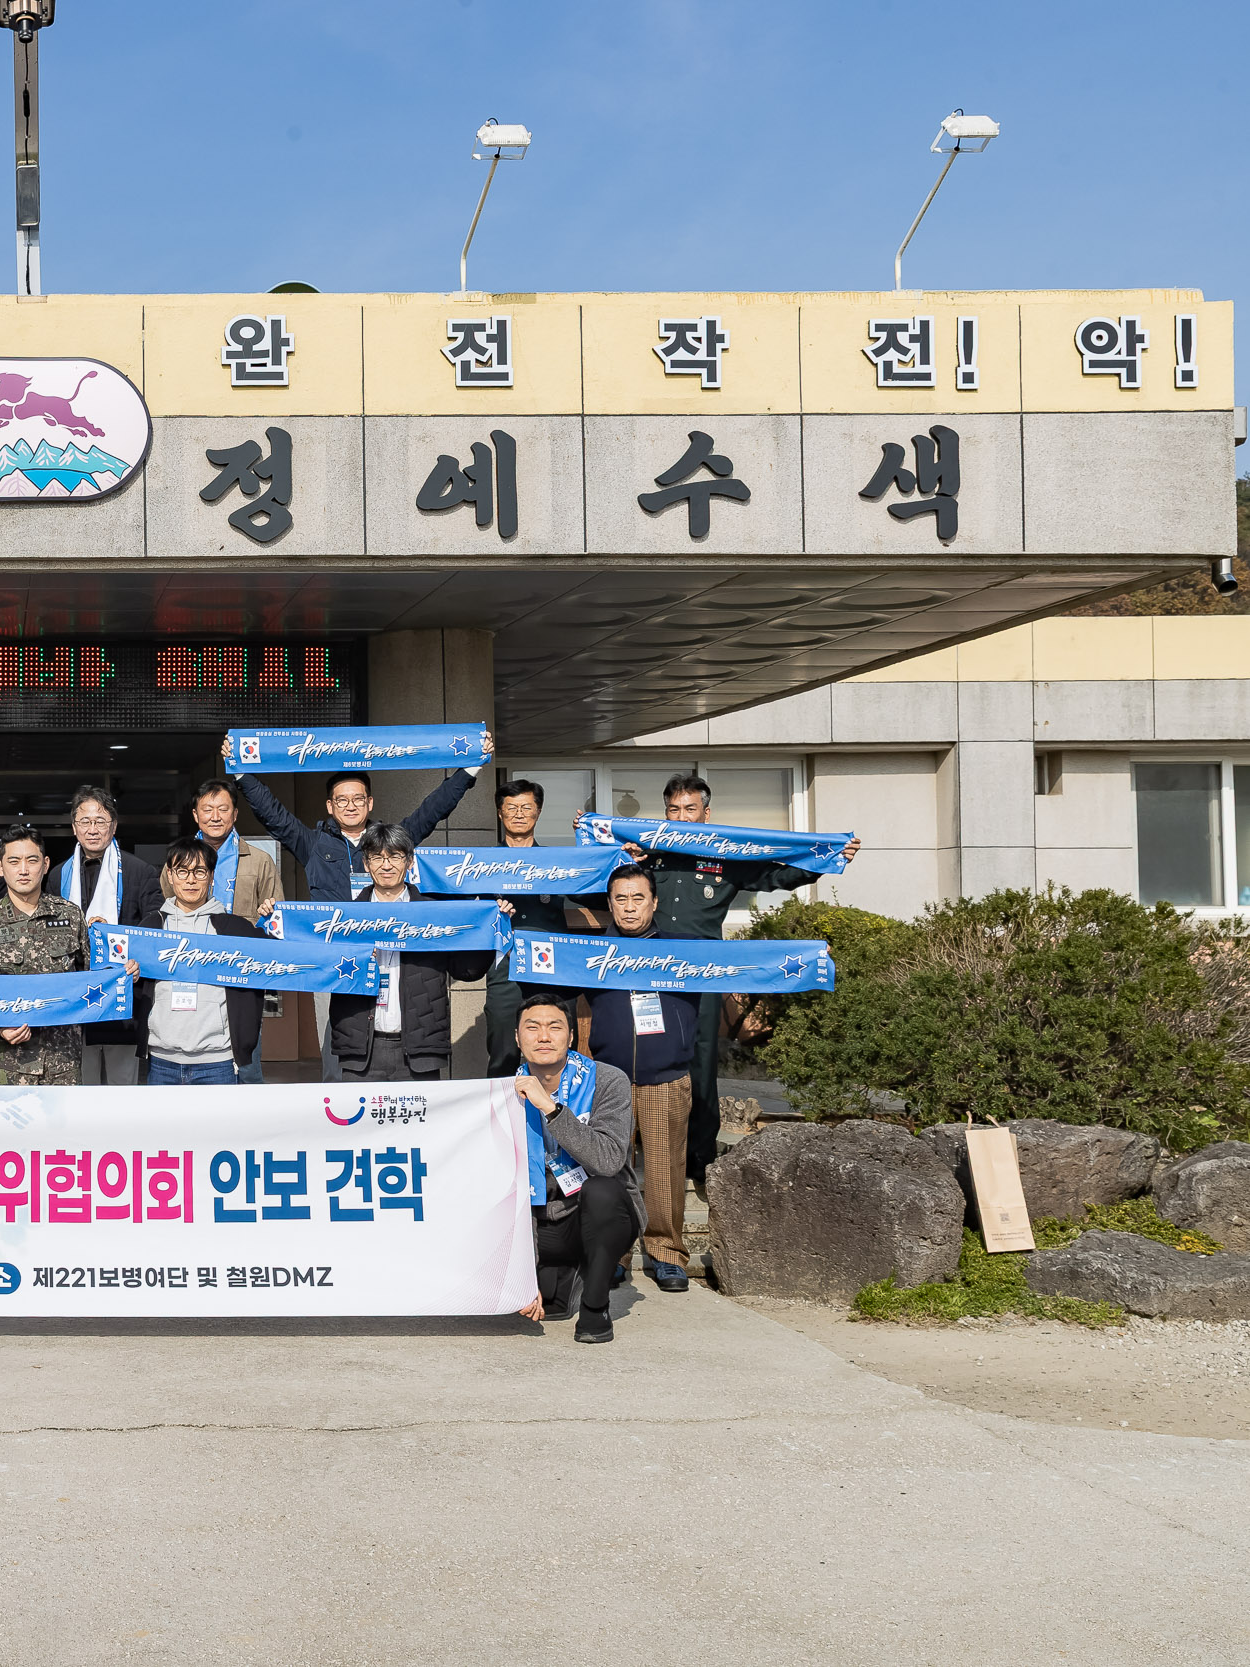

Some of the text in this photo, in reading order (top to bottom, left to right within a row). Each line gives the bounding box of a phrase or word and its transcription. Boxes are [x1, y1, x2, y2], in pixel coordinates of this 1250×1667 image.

[371, 1095, 427, 1108] 소통하며 발전하는
[370, 1106, 427, 1125] 행복광진
[209, 1149, 312, 1223] 안보
[324, 1146, 428, 1222] 견학
[32, 1265, 190, 1290] 제221보병여단
[197, 1267, 219, 1289] 및
[225, 1264, 334, 1289] 철원DMZ
